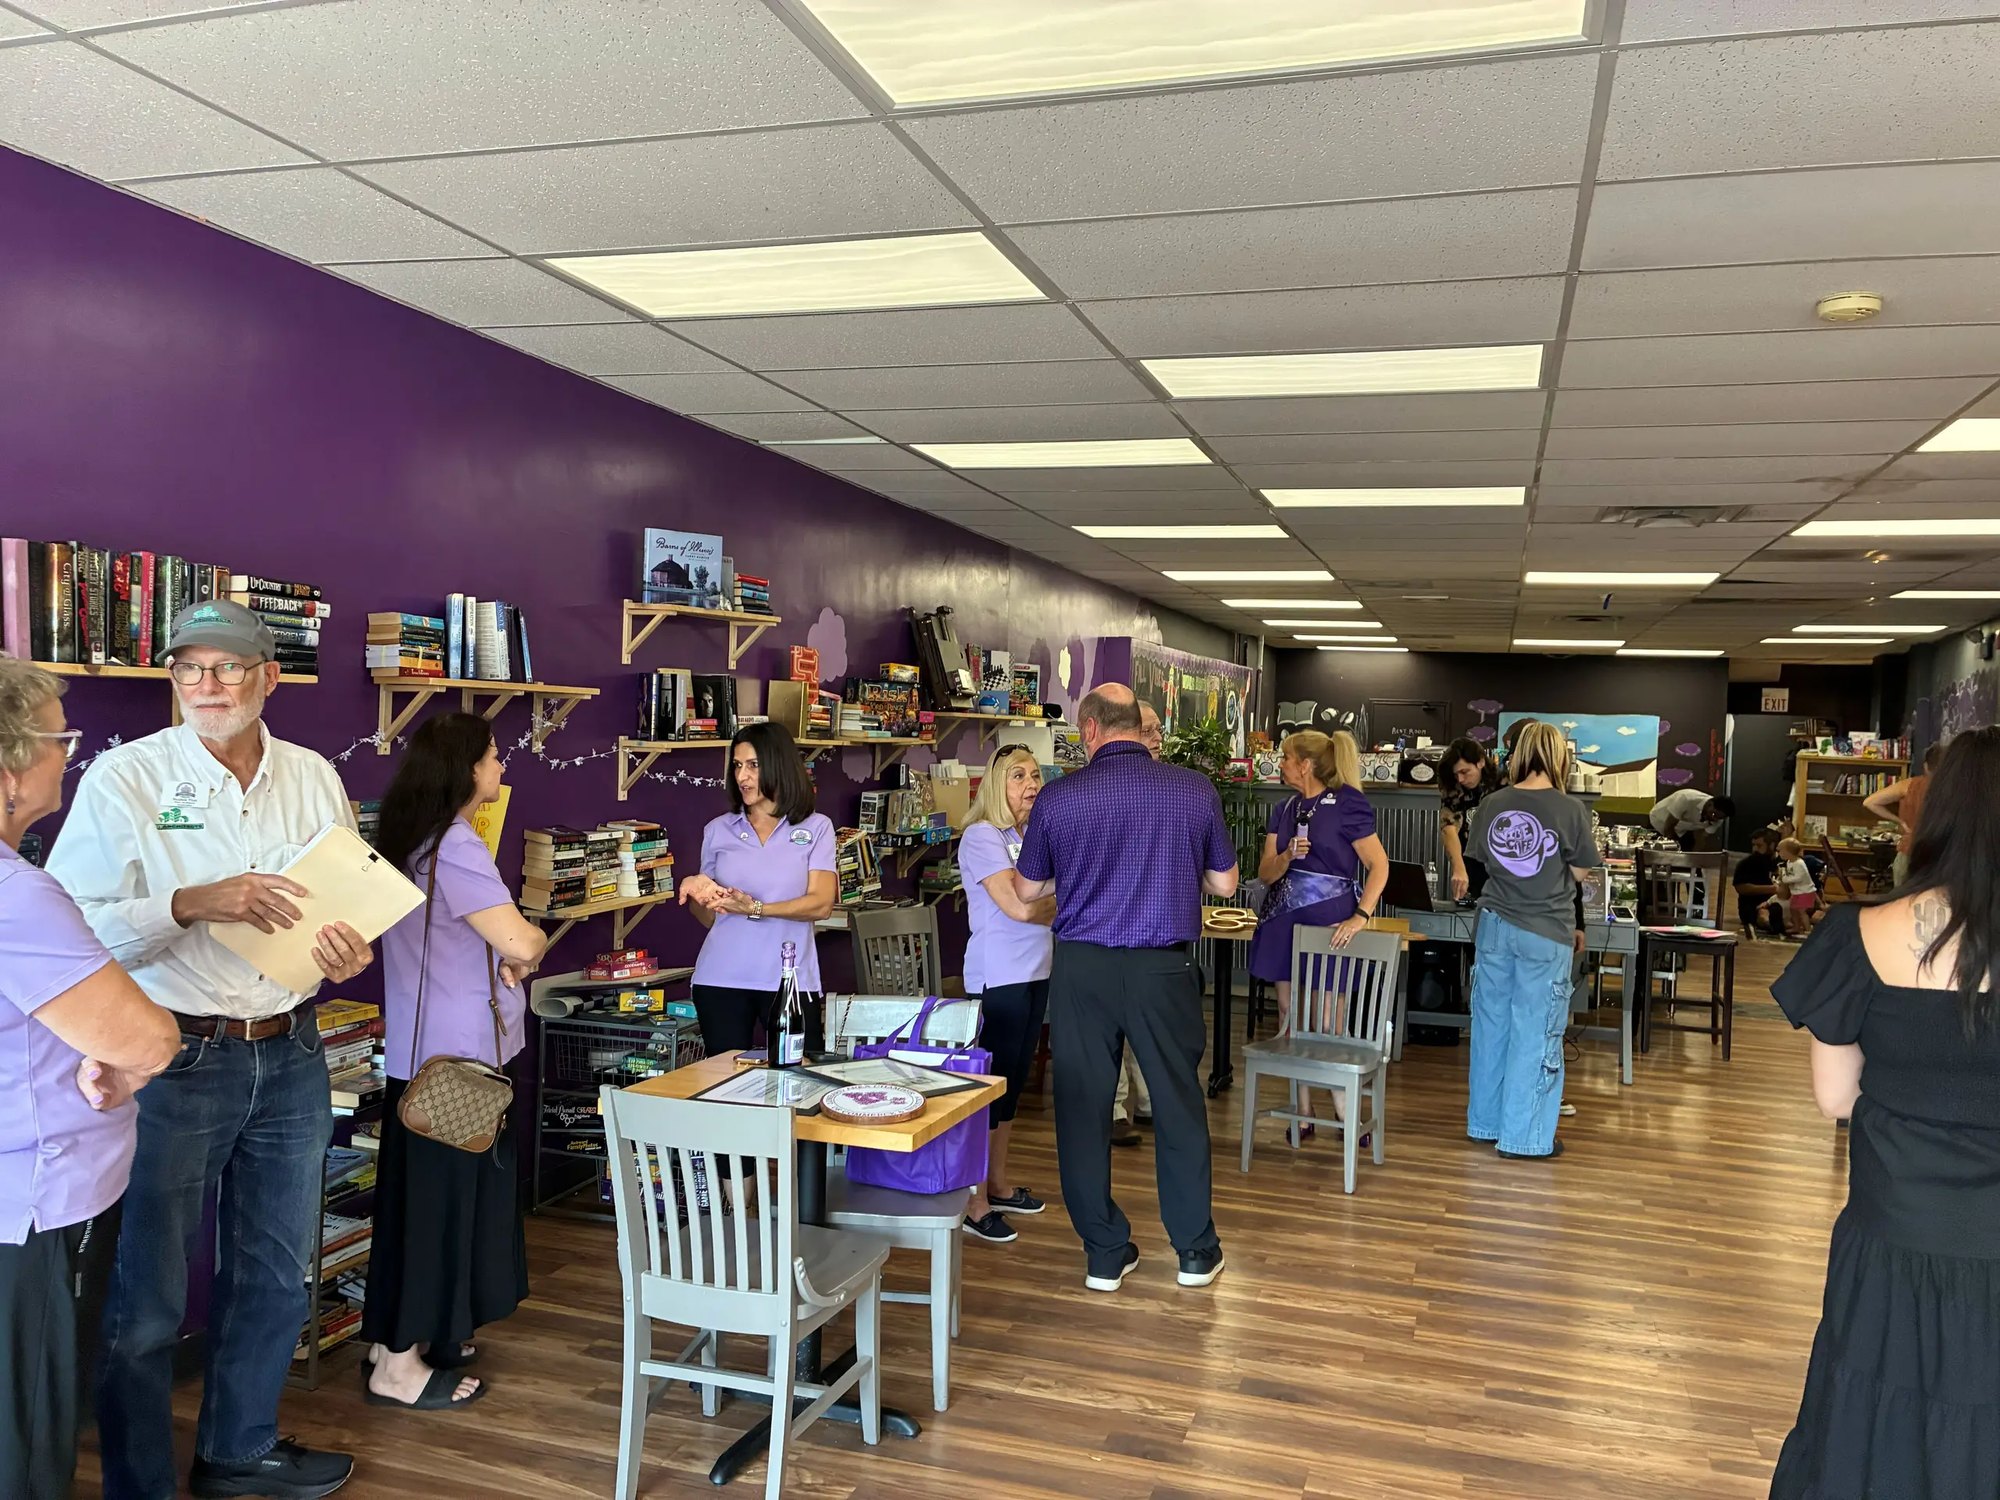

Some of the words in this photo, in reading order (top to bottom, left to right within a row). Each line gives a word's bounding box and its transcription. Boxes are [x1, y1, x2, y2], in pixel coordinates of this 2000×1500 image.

[656, 537, 679, 549] Barns
[680, 541, 690, 556] of
[688, 541, 714, 555] Illinois
[61, 562, 73, 586] City
[259, 578, 282, 592] COUNTRY
[89, 588, 99, 615] STORIES
[259, 596, 298, 612] FEEDBACK
[63, 598, 73, 628] Glass
[866, 683, 908, 703] Risk
[1764, 697, 1787, 712] EXIT
[1408, 728, 1427, 736] ROOM
